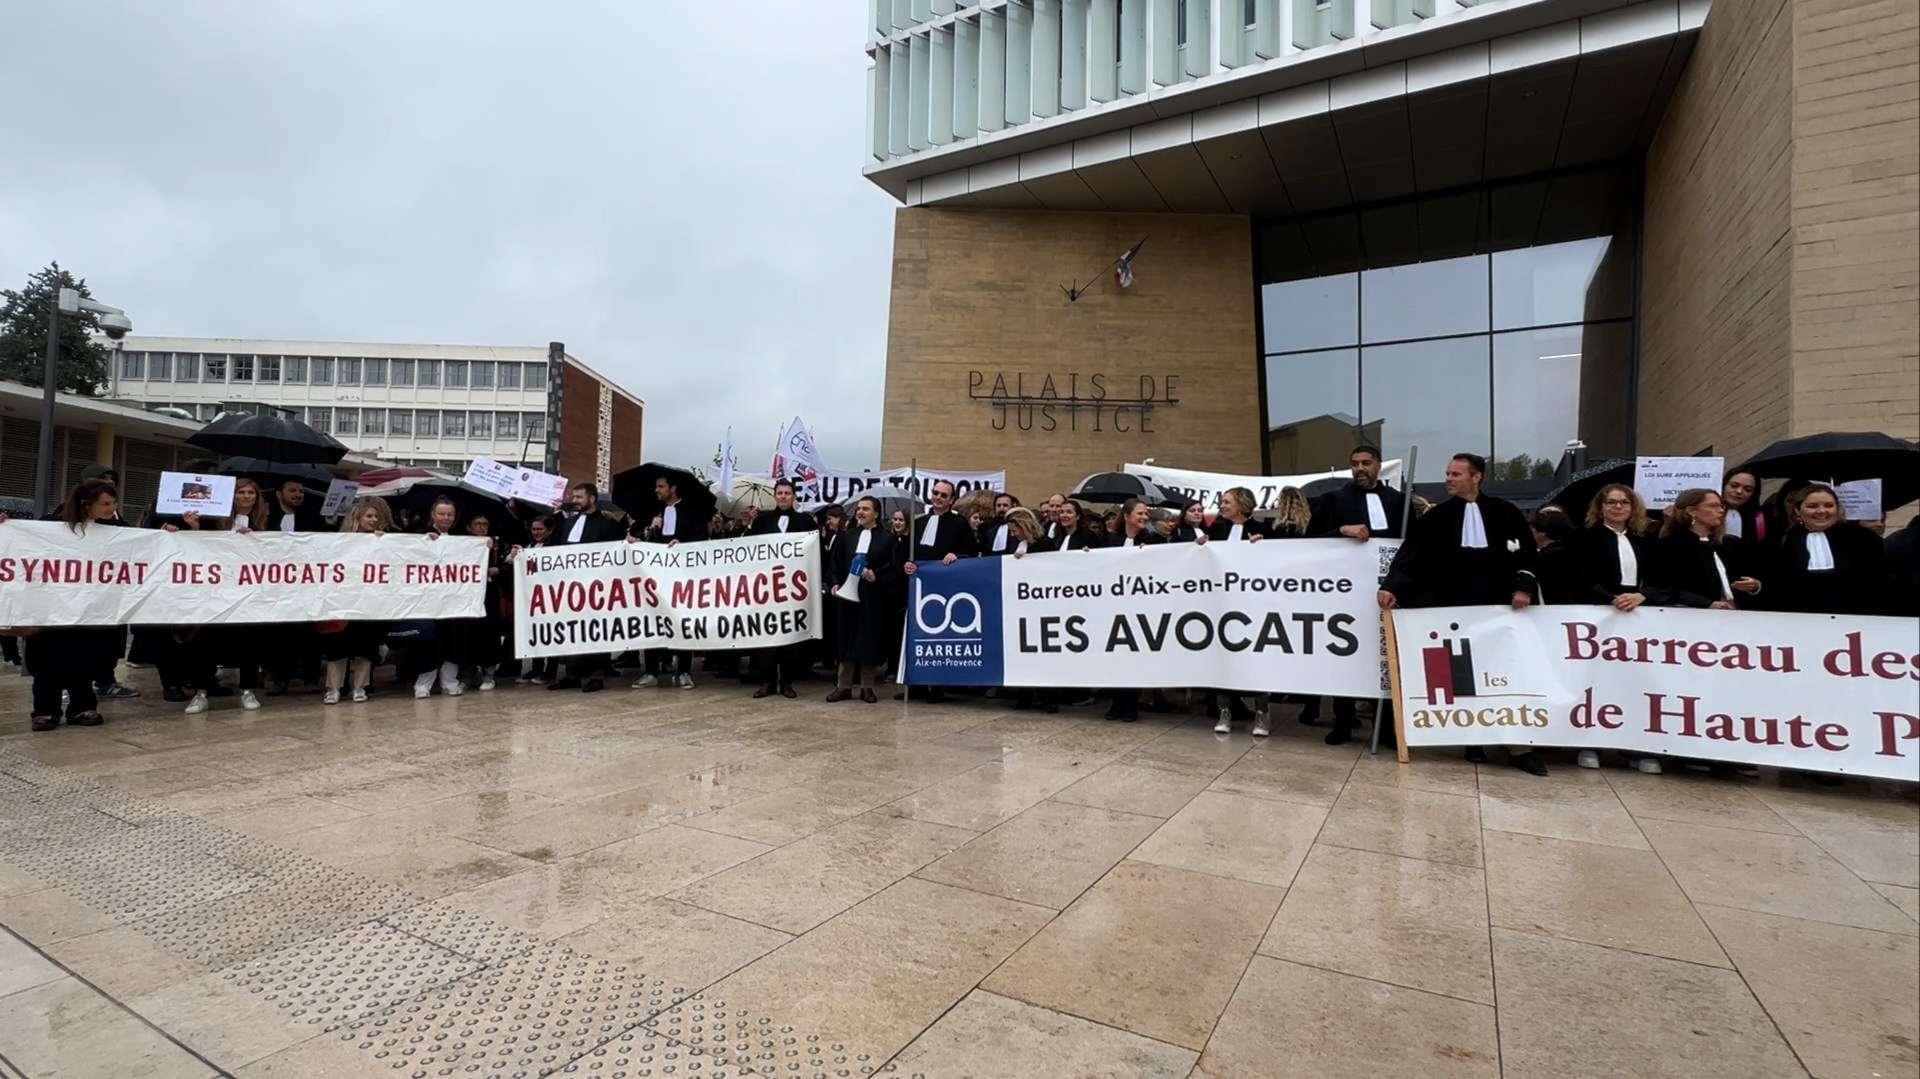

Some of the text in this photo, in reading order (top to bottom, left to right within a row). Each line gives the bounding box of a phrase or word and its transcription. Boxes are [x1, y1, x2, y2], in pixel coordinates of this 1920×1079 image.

[968, 370, 1180, 403] PALAIS DE
[991, 403, 1155, 433] JUSTICE
[0, 557, 482, 586] SYNDICAT DES AVOCATS DE FRANCE
[540, 541, 805, 572] BARREAU D'AIX EN PROVENCE
[529, 576, 660, 617] AVOCATS
[1017, 571, 1353, 600] Barreau d'Aix-en-Provence
[915, 577, 982, 634] ba
[528, 608, 808, 647] JUSTICIABLES EN DANGER
[1018, 610, 1360, 657] LES AVOCATS
[914, 658, 983, 667] Aix-en-Provence
[915, 644, 982, 657] BARREAU
[1561, 621, 1801, 673] Barreau
[1483, 672, 1509, 688] les
[1412, 703, 1549, 729] avocats
[1568, 686, 1919, 758] de Haute P
